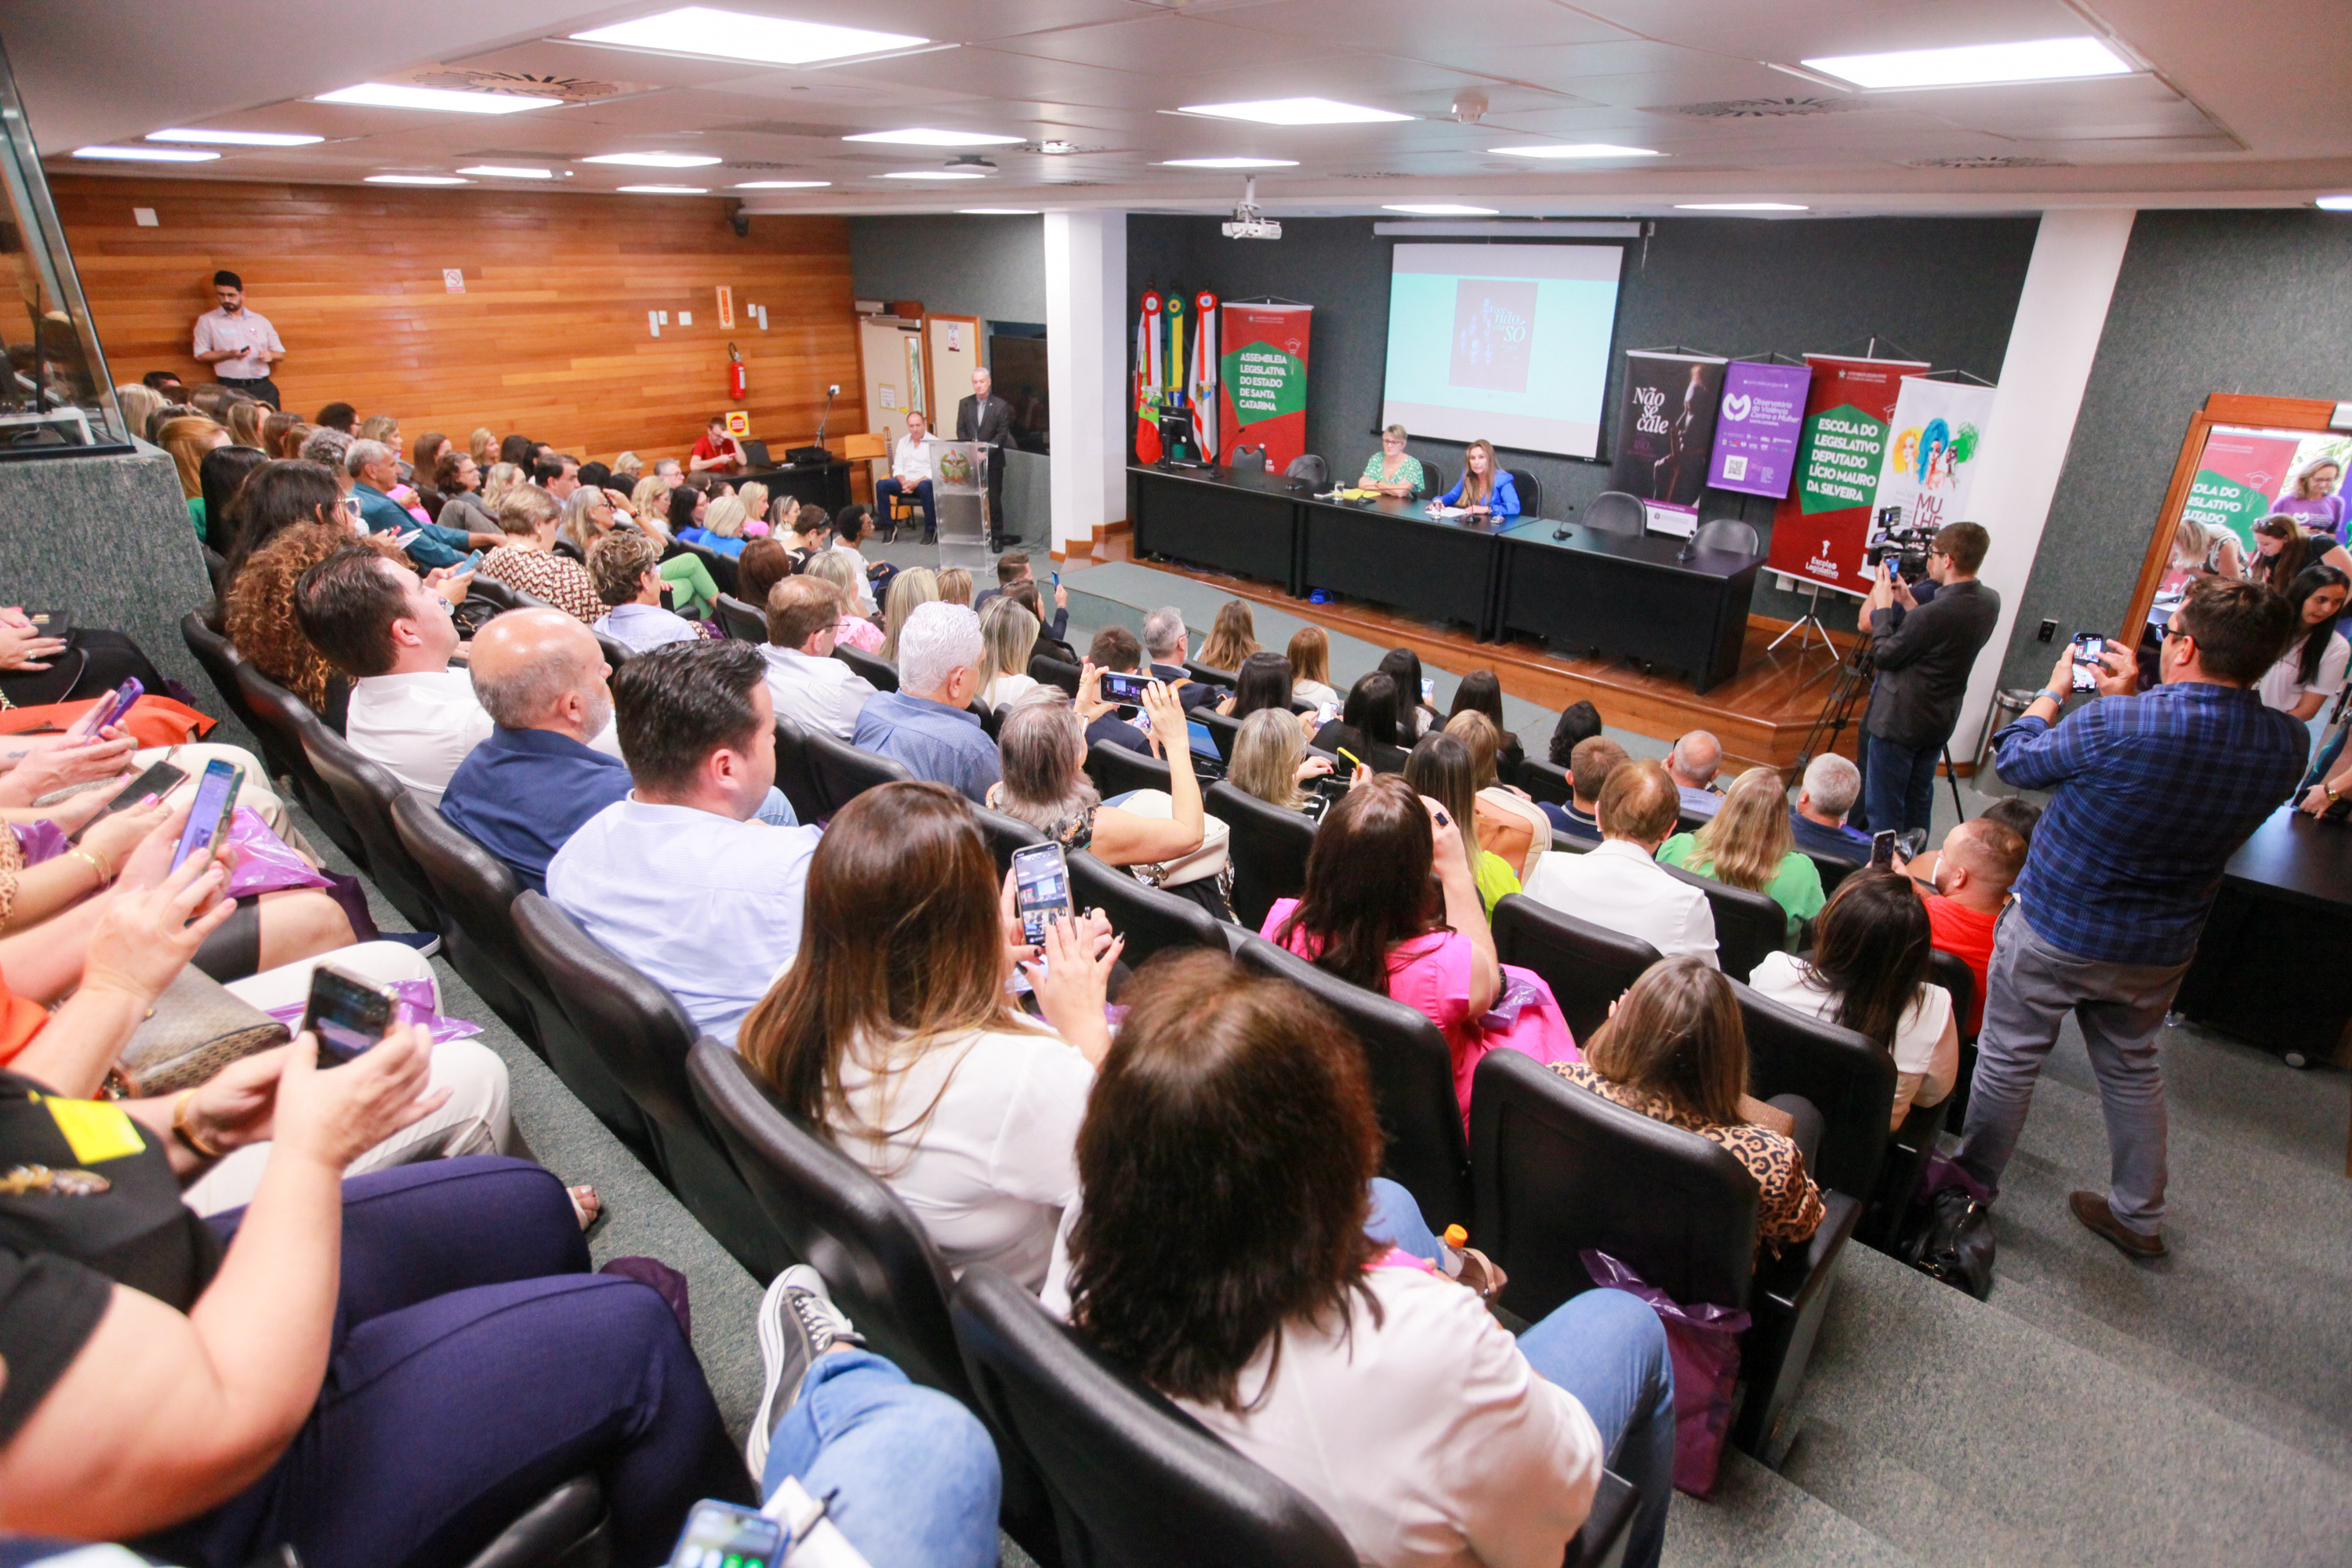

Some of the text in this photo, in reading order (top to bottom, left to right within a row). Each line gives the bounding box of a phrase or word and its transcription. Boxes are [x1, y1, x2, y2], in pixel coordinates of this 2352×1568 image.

[1494, 310, 1521, 325] não
[1240, 353, 1287, 364] ASSEMBLEIA
[1240, 364, 1287, 376] LEGISLATIVA
[1240, 376, 1283, 388] DO ESTADO
[1240, 387, 1276, 399] DE SANTA
[1632, 387, 1665, 407] Não
[1239, 399, 1277, 412] CATARINA
[1642, 405, 1659, 419] se
[1636, 415, 1669, 434] cale
[1818, 418, 1878, 437] ESCOLA DO
[1814, 433, 1880, 455] LEGISLATIVO
[1811, 448, 1867, 469] DEPUTADO
[1809, 462, 1877, 487] LÍCIO MAURO
[1806, 479, 1864, 502] DA SILVEIRA
[2192, 483, 2241, 499] OLA DO
[1916, 492, 1943, 514] MU
[1806, 561, 1839, 577] Legislativo
[1811, 556, 1832, 568] Escola
